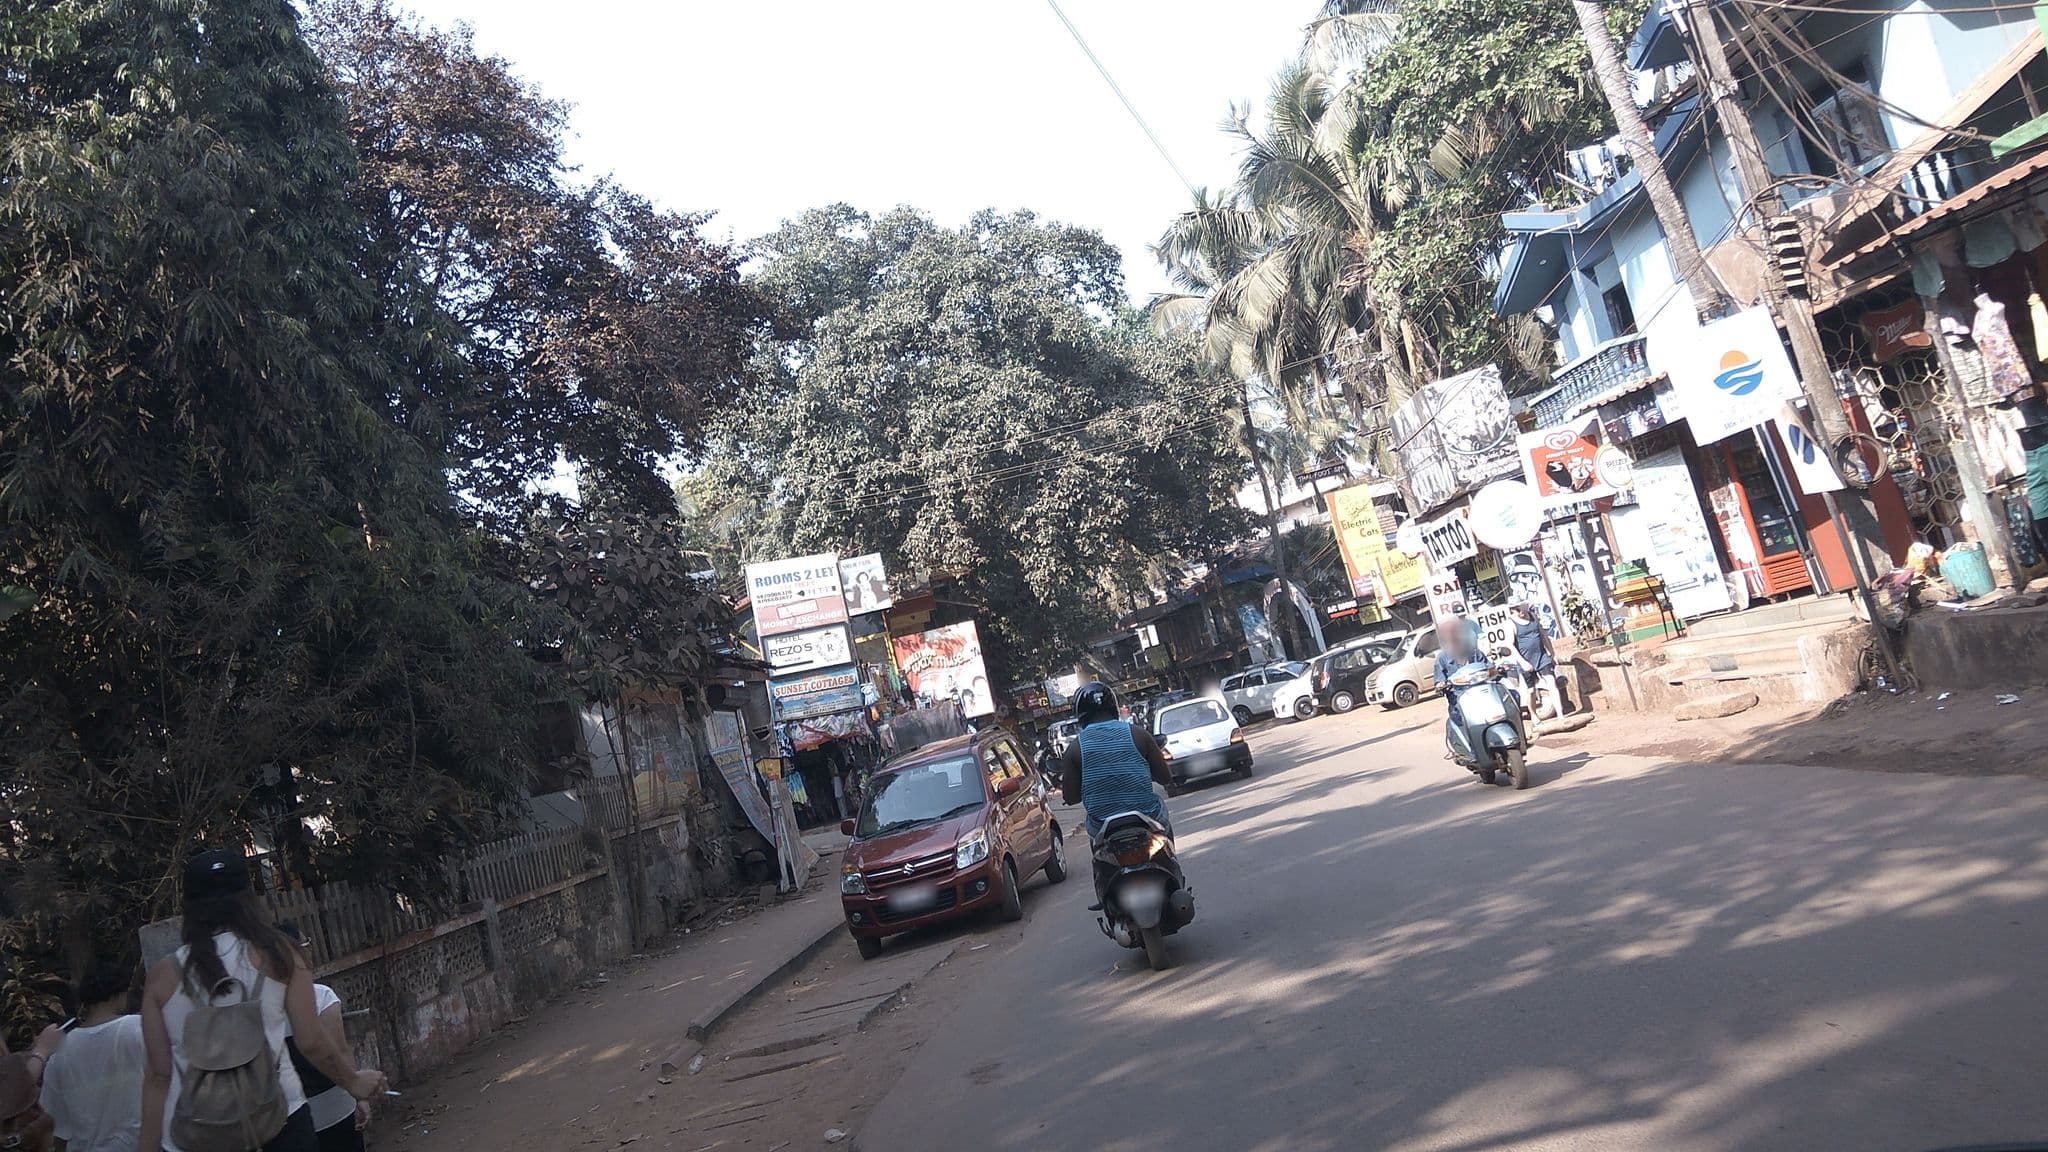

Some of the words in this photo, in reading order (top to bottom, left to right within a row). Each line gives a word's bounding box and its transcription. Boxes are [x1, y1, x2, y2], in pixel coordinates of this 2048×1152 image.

[1313, 468, 1330, 478] FOOT
[1342, 517, 1372, 530] Electric
[1359, 527, 1379, 538] Cats
[1422, 519, 1471, 563] TATTOO
[755, 571, 801, 588] ROOMS
[804, 569, 812, 580] 2
[815, 566, 835, 578] LET
[762, 616, 795, 629] MONEY
[1477, 610, 1507, 628] FISH
[775, 635, 804, 645] HOTEL
[769, 642, 813, 658] REZO'S
[775, 682, 809, 696] SUNSET
[810, 674, 855, 690] COTTAGES
